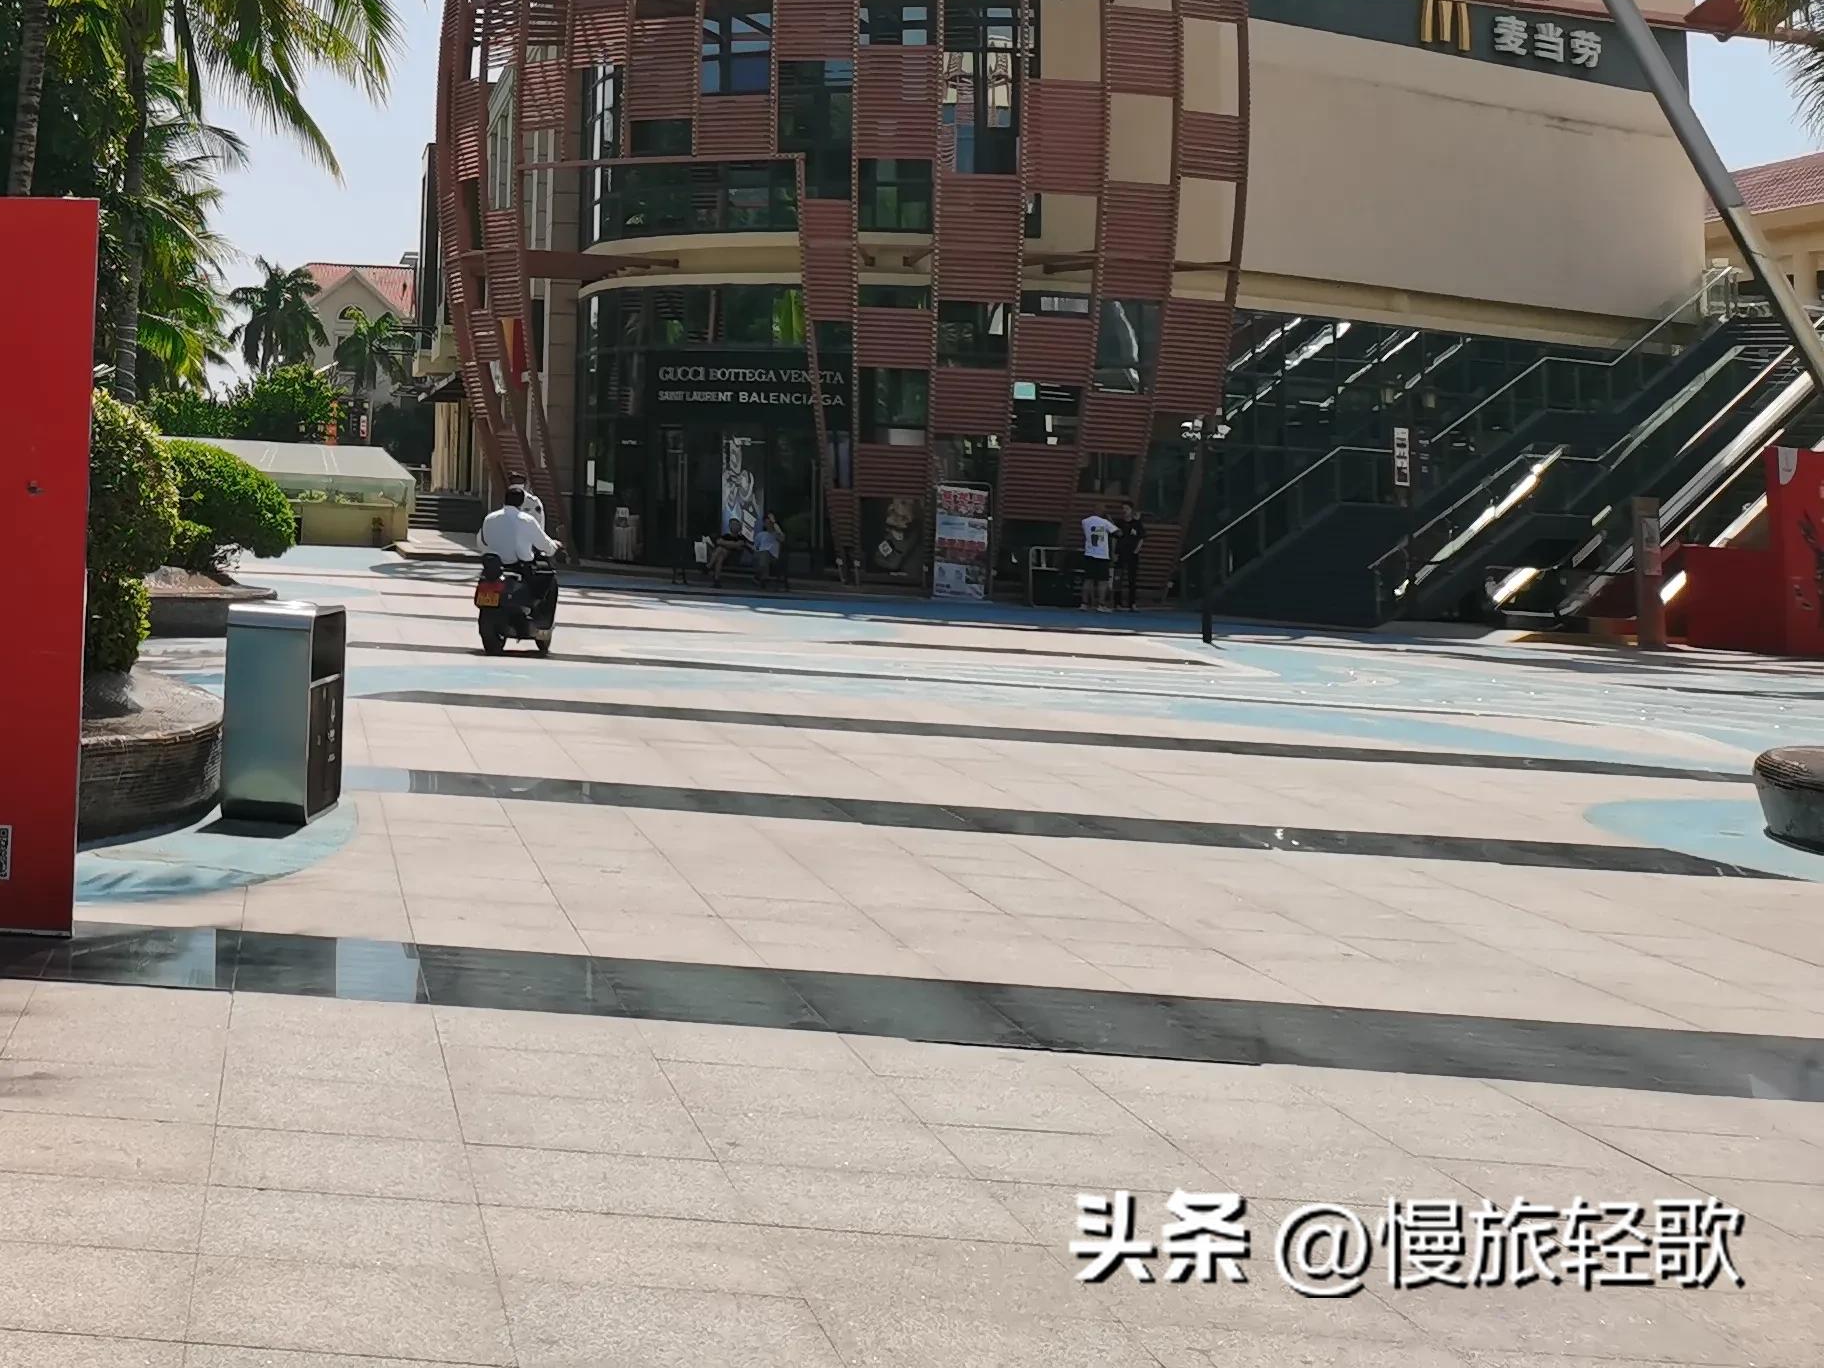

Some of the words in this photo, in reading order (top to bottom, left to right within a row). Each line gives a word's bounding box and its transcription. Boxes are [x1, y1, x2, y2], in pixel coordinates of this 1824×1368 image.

[1493, 15, 1602, 68] 麦当劳
[658, 366, 705, 382] GUCCI
[709, 367, 775, 383] BOTTEGA
